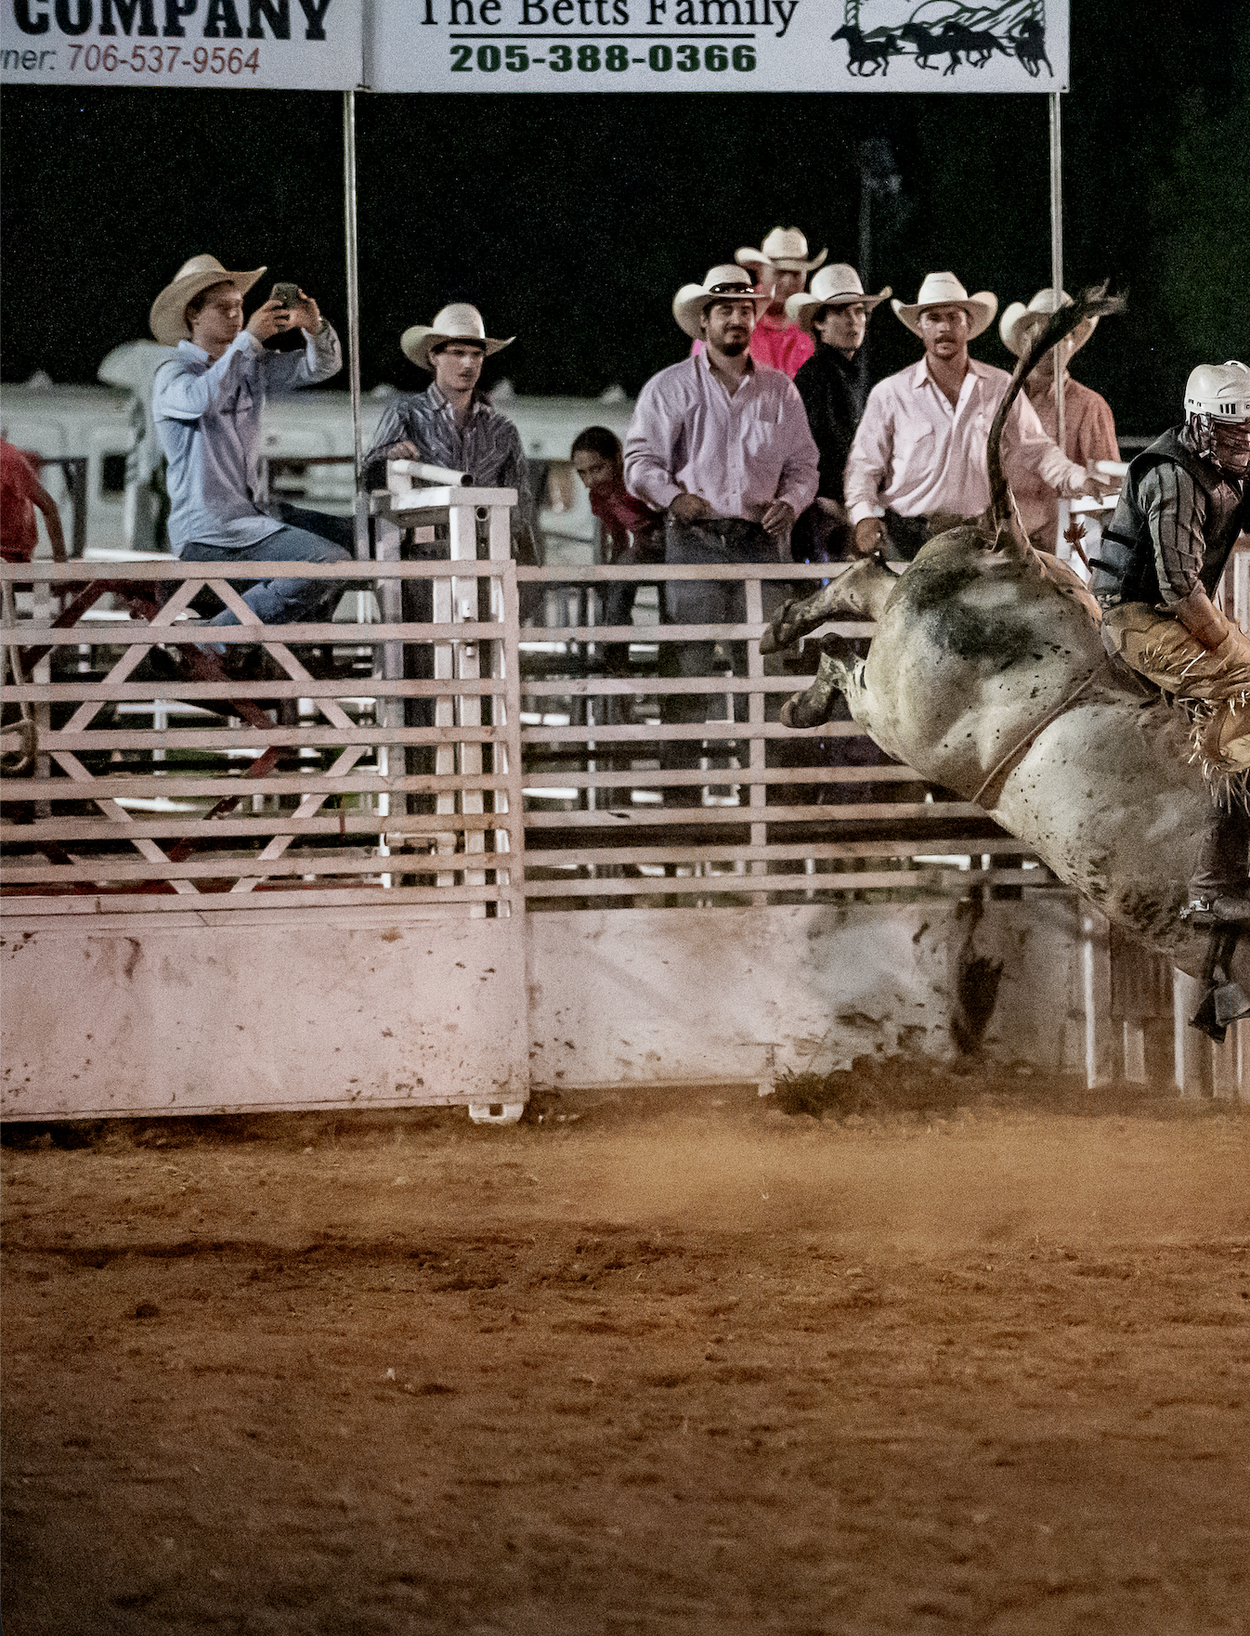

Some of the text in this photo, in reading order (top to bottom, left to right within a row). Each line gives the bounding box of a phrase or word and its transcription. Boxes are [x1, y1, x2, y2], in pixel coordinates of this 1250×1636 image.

[13, 0, 334, 41] COMPANY
[420, 0, 800, 38] The Betts Family
[1, 44, 261, 74] ner: 706-537-9564
[449, 44, 757, 73] 205-388-0366
